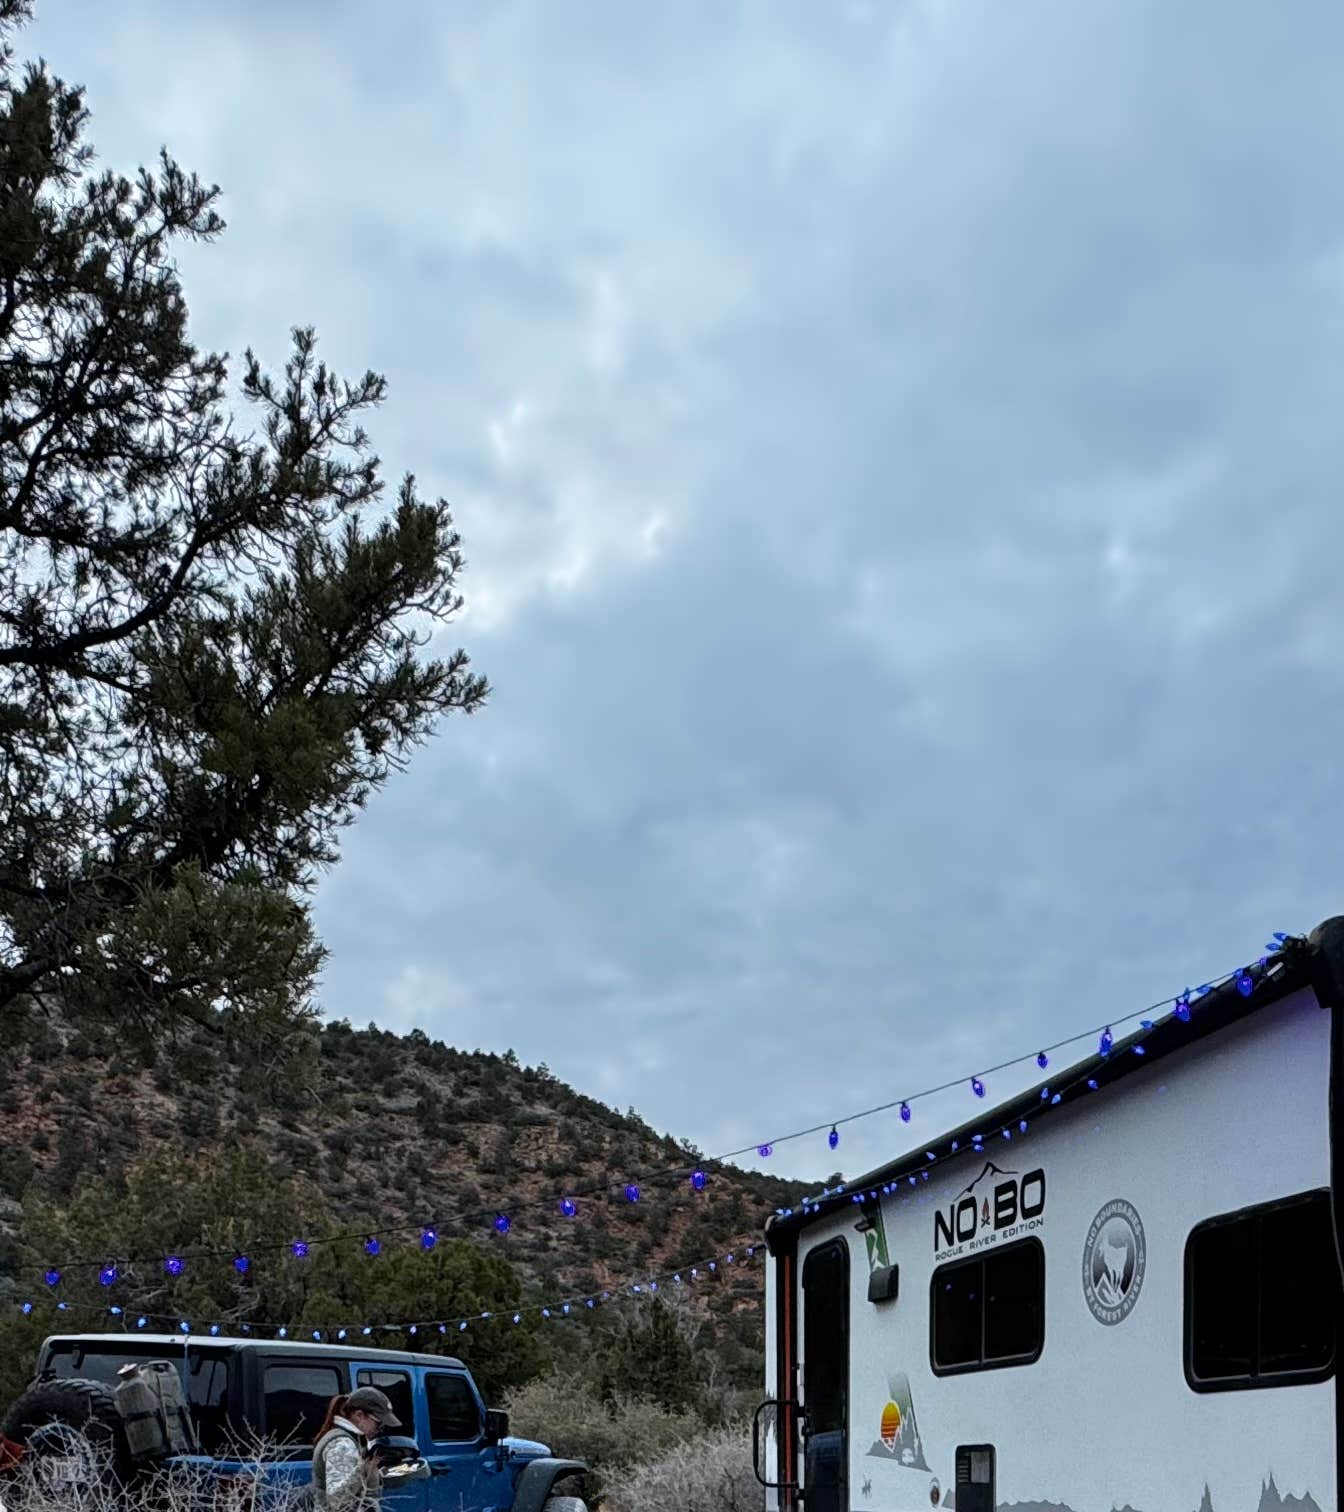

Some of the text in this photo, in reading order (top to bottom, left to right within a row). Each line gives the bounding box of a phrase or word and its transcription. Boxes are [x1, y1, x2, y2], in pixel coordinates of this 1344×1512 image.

[935, 1217, 1044, 1261] ROGUE RIVER EDITION
